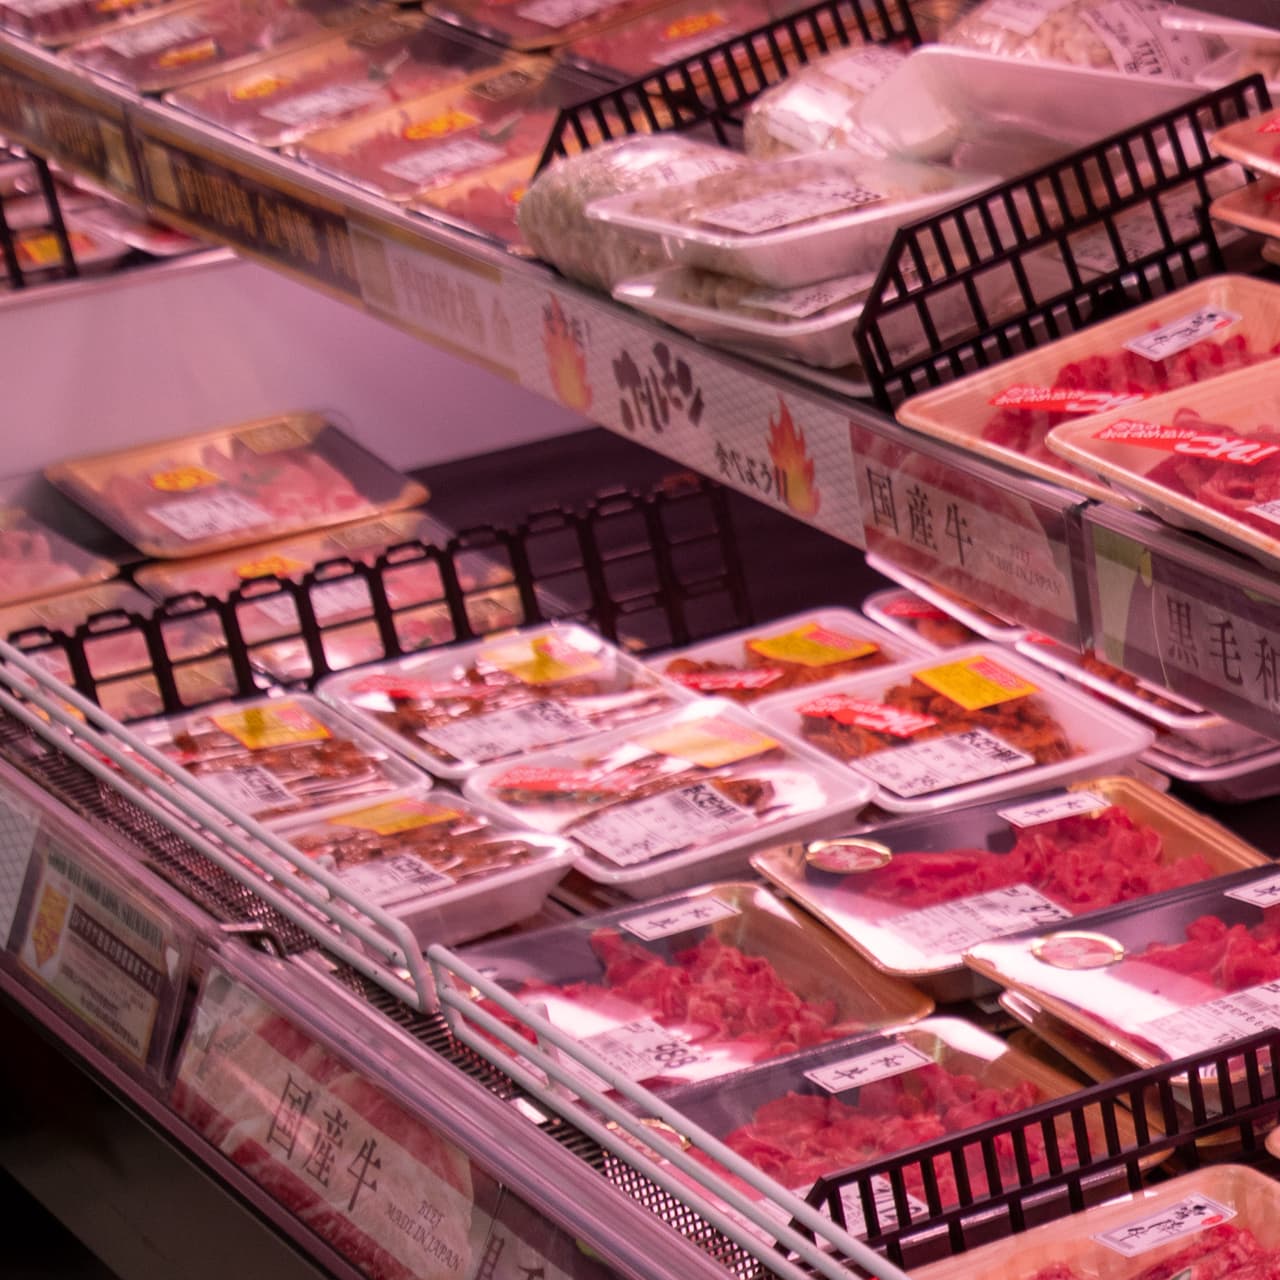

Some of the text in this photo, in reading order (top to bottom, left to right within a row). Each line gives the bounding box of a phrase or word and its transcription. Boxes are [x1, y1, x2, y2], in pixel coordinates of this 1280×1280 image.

[866, 467, 974, 566] 国産牛
[265, 1072, 384, 1212] 国産牛
